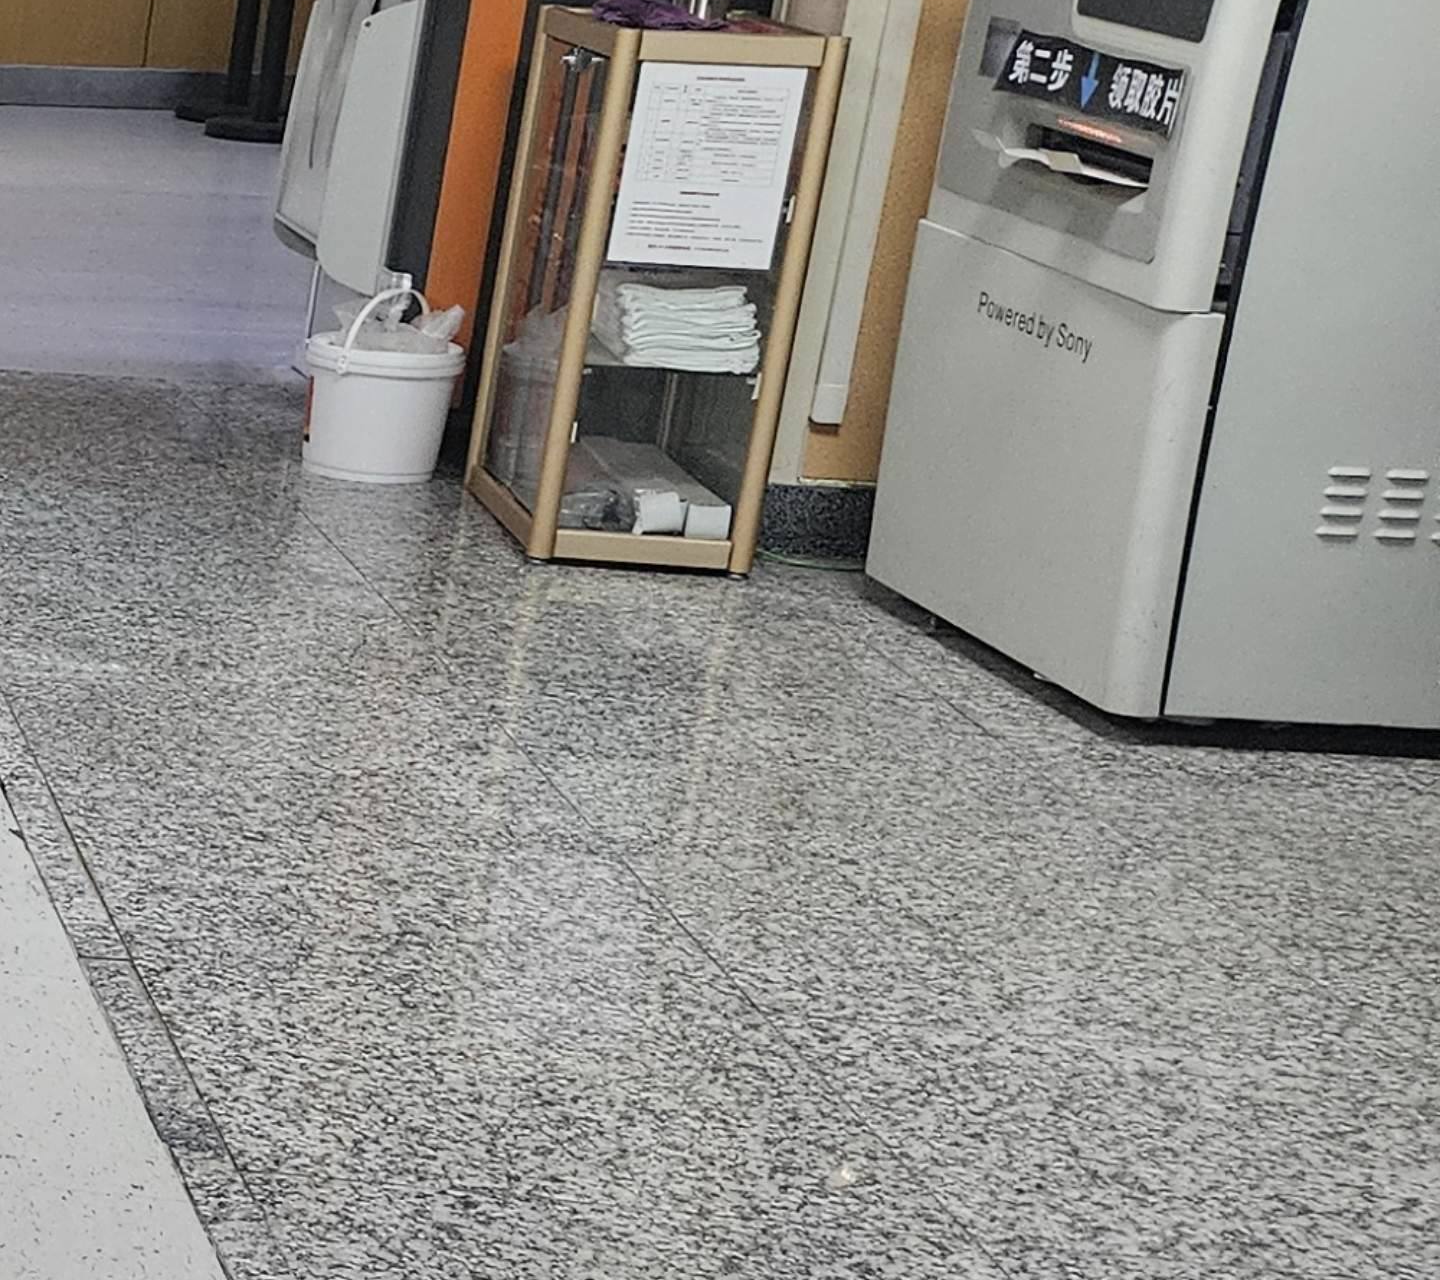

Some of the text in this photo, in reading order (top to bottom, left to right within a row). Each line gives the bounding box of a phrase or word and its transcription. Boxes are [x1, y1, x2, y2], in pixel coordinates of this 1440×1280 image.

[1008, 41, 1180, 131] 第二步 领取胶片
[977, 291, 1092, 364] Powered by Sony
